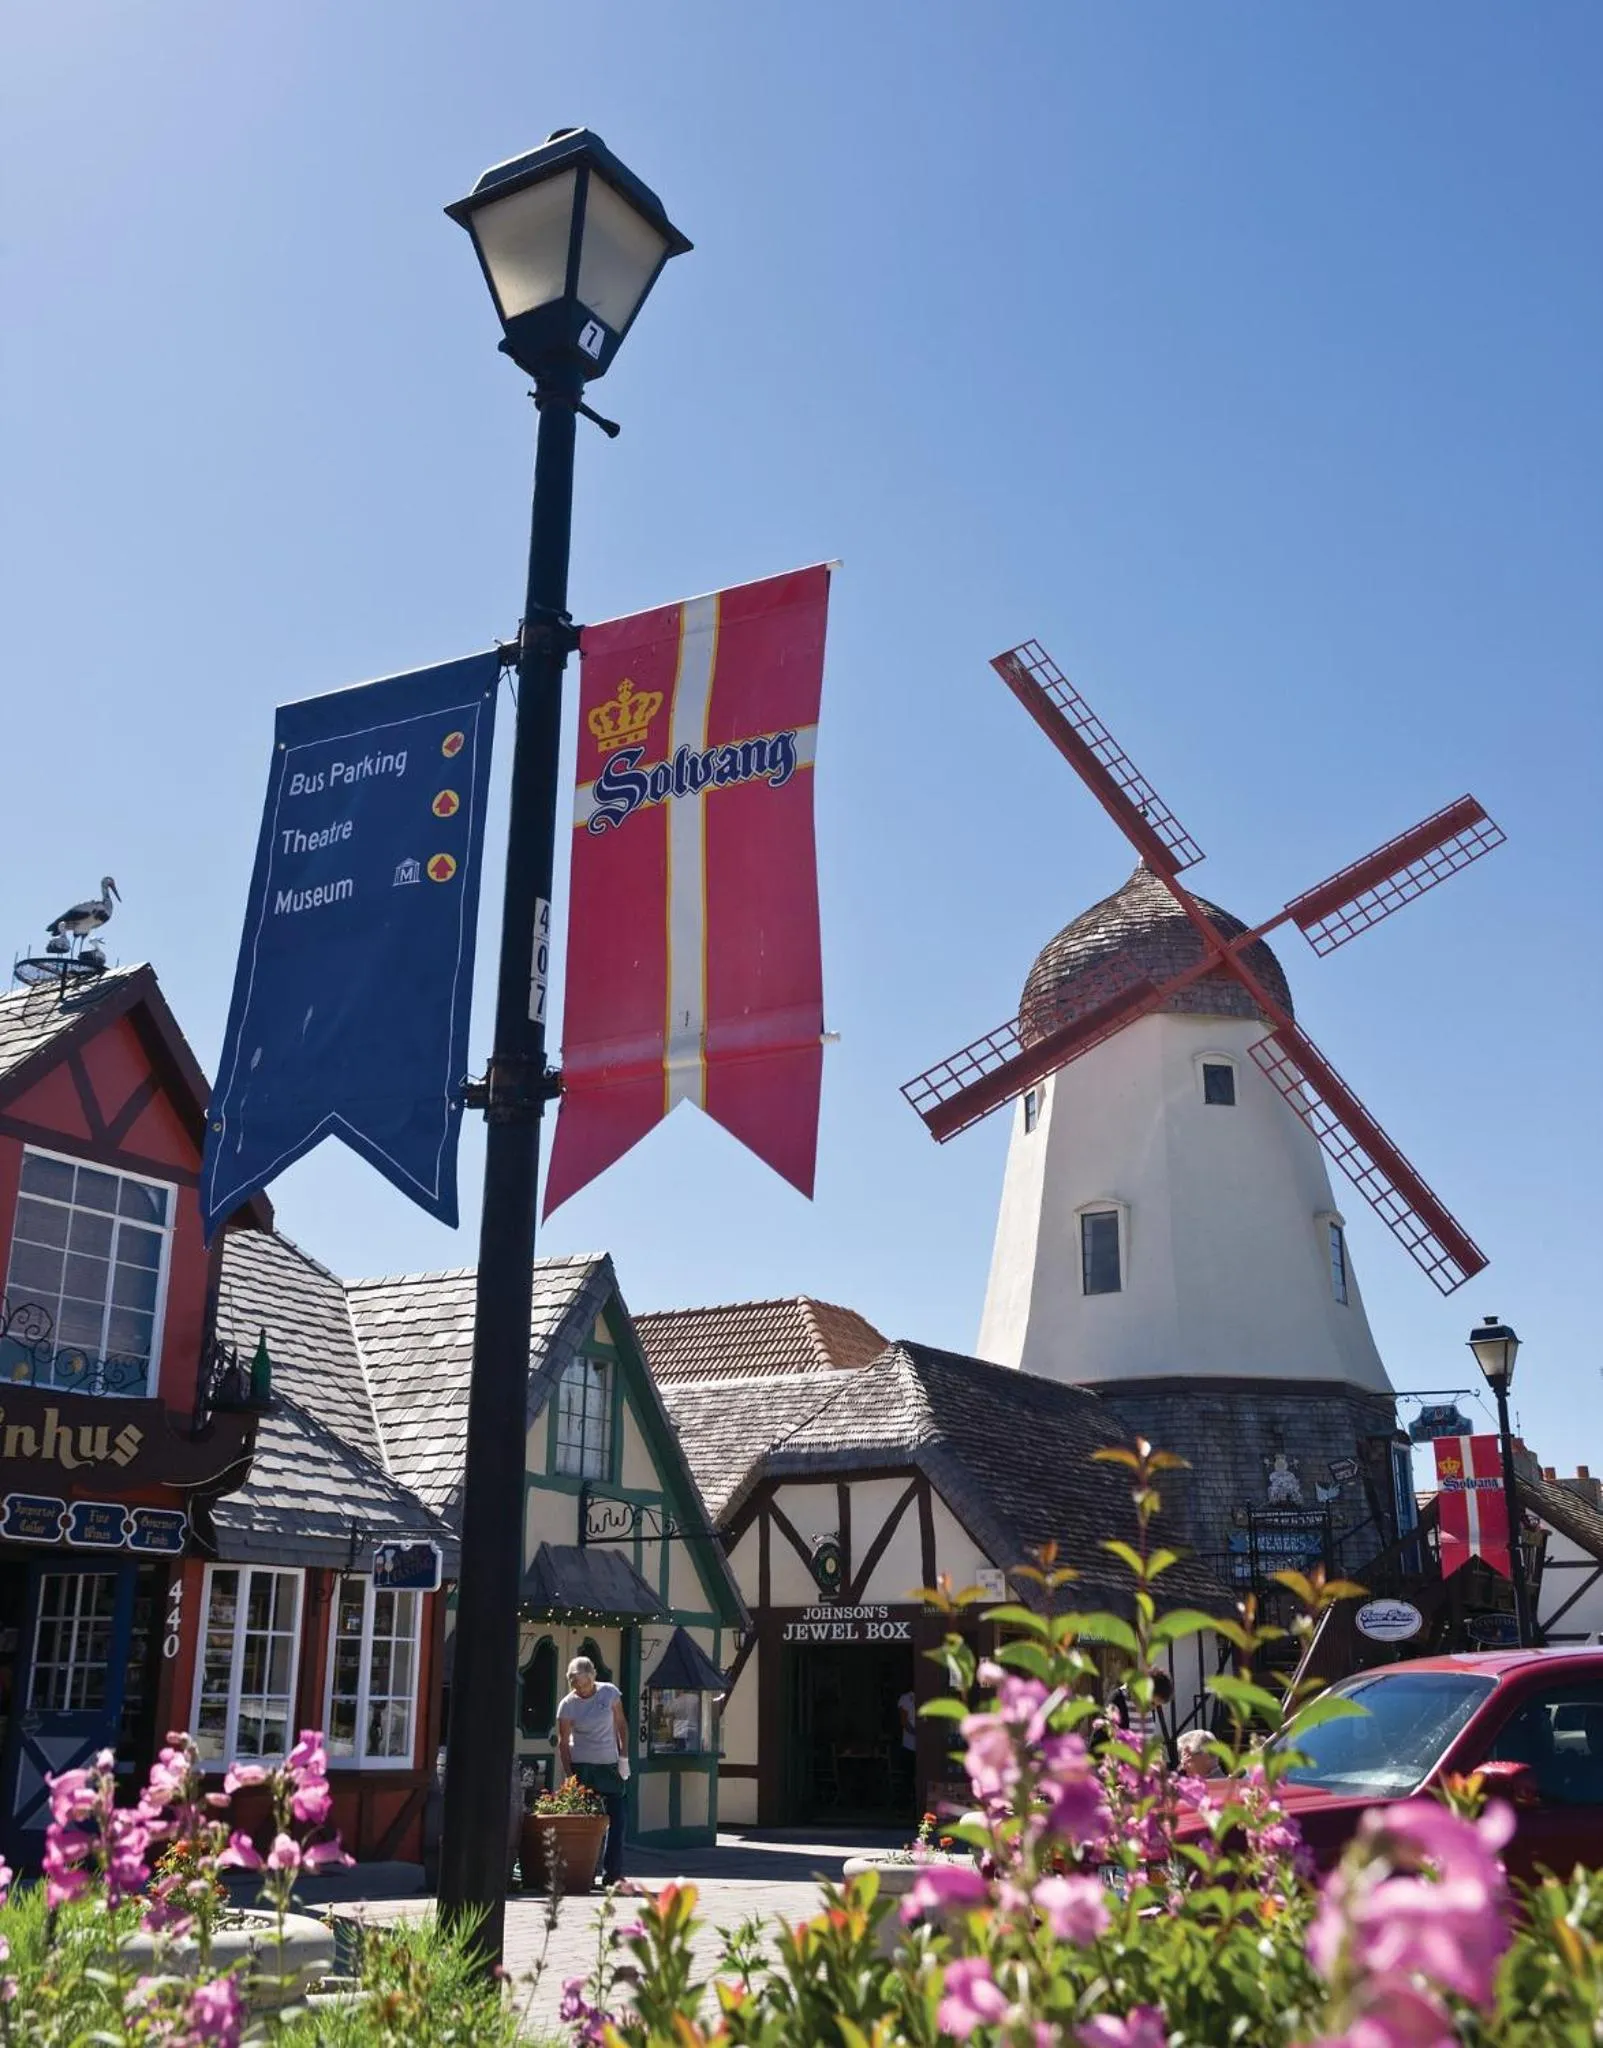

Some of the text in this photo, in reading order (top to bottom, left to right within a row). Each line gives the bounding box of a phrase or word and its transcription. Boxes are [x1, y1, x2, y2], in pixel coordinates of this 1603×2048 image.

[289, 750, 408, 796] Bus Parking
[588, 731, 797, 835] Solvang
[282, 820, 353, 854] Theatre
[274, 878, 353, 915] Museum
[537, 904, 549, 1015] 407
[0, 1407, 144, 1470] nhus
[163, 1579, 183, 1659] 440
[782, 1621, 911, 1640] JEWEL BOX
[803, 1606, 889, 1620] JOHNSON'S
